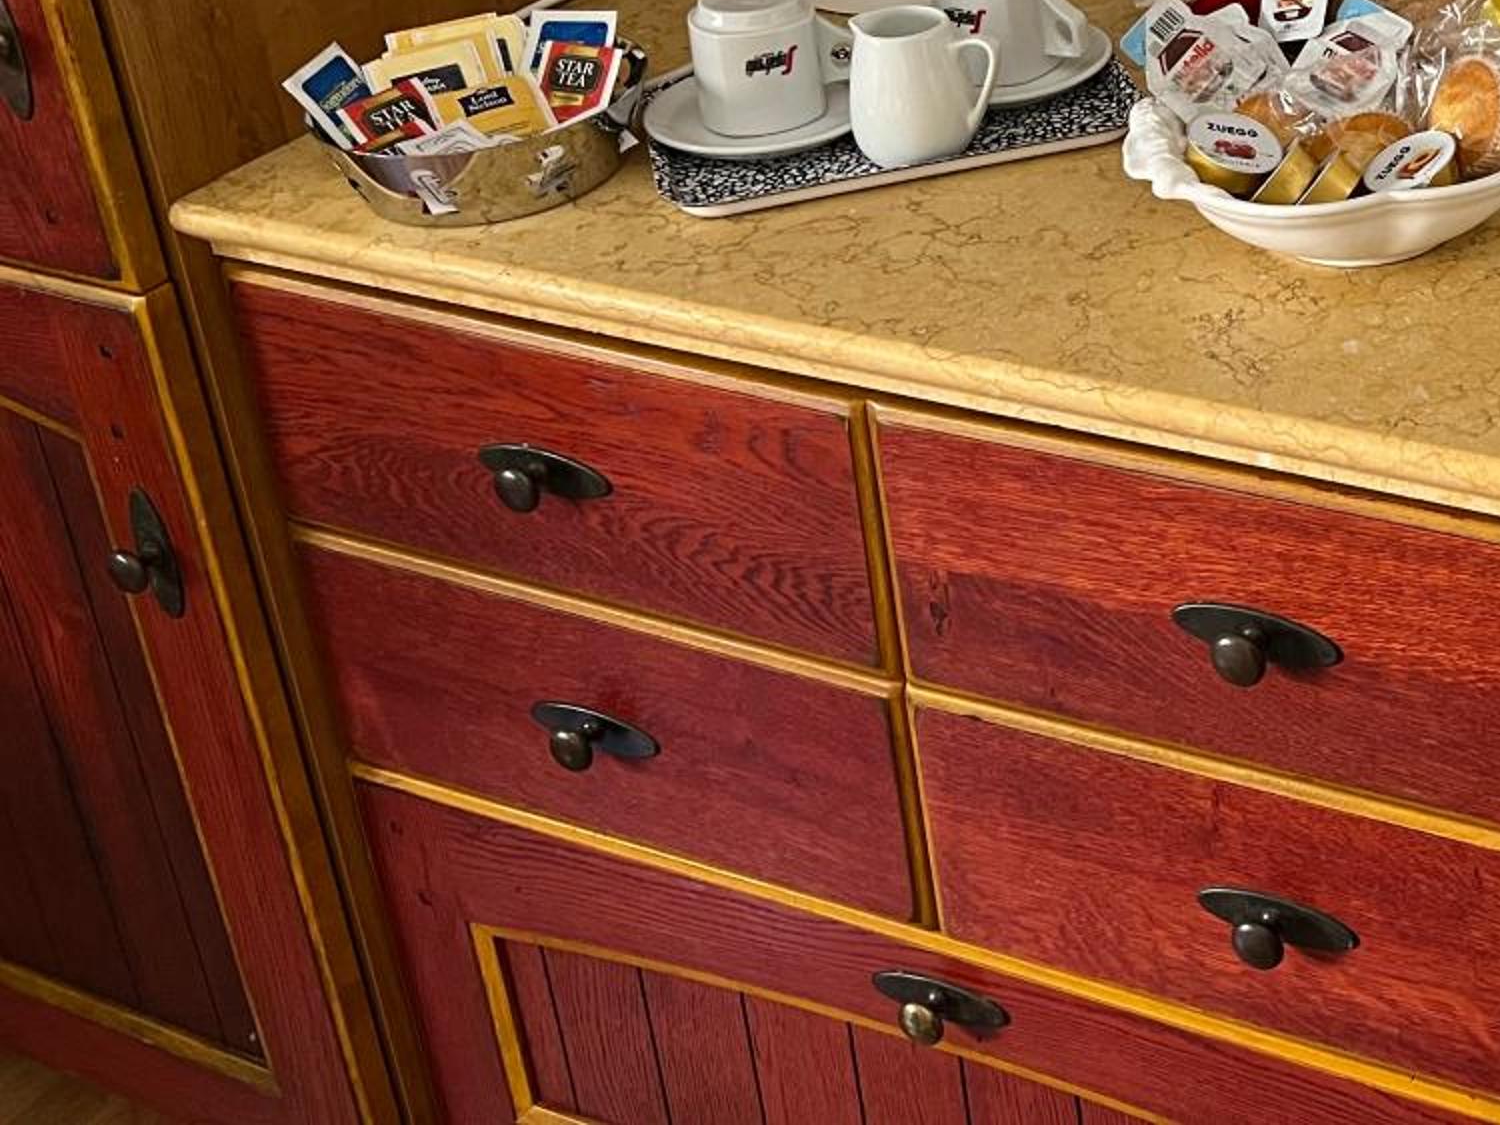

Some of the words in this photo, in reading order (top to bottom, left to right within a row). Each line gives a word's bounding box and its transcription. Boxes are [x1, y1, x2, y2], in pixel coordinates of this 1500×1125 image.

[556, 58, 595, 75] STAR
[557, 72, 587, 88] TEA
[369, 98, 416, 126] STAR
[467, 95, 508, 112] Nelson
